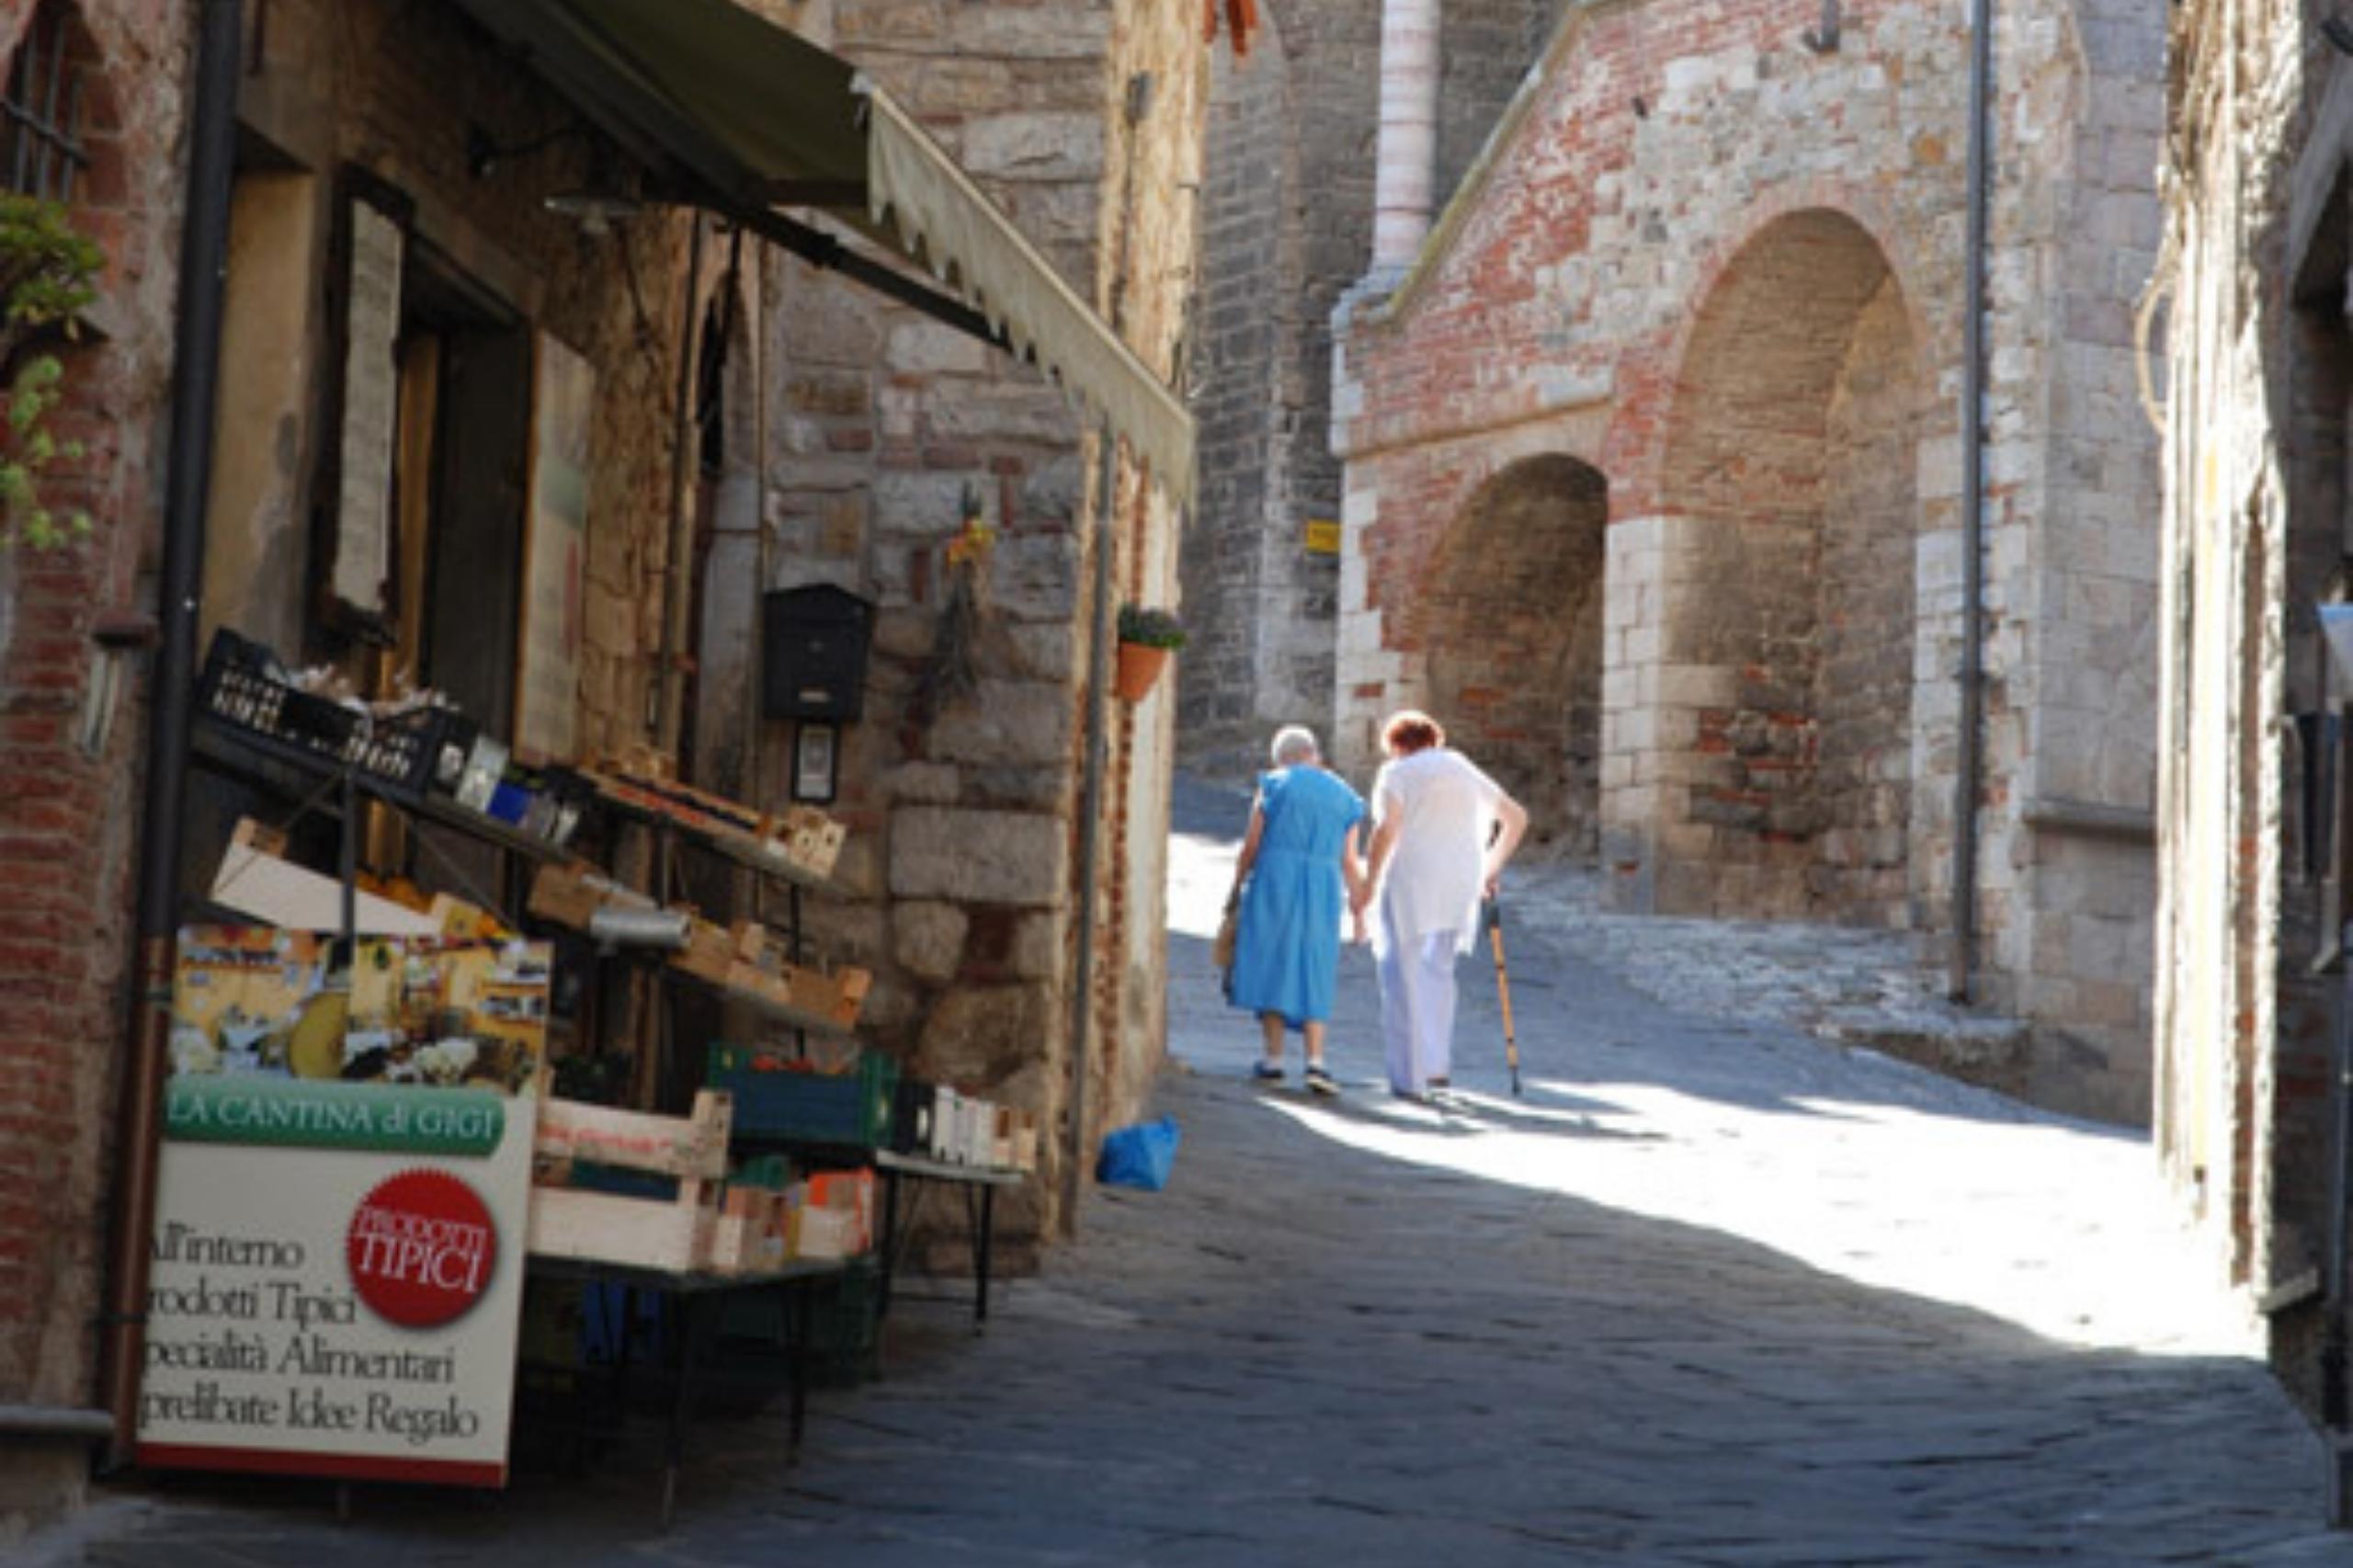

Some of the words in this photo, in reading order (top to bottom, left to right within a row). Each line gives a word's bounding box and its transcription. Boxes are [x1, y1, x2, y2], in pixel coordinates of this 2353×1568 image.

[167, 1093, 209, 1125] LA
[217, 1096, 374, 1132] CANTINA
[416, 1106, 494, 1140] GIGI
[355, 1205, 488, 1256] PRODOTTI
[358, 1232, 482, 1294] TIPICI
[267, 1280, 357, 1332] Tipici
[276, 1333, 455, 1384] Alimentari
[286, 1388, 358, 1432] Idee
[365, 1391, 480, 1447] Regalo
